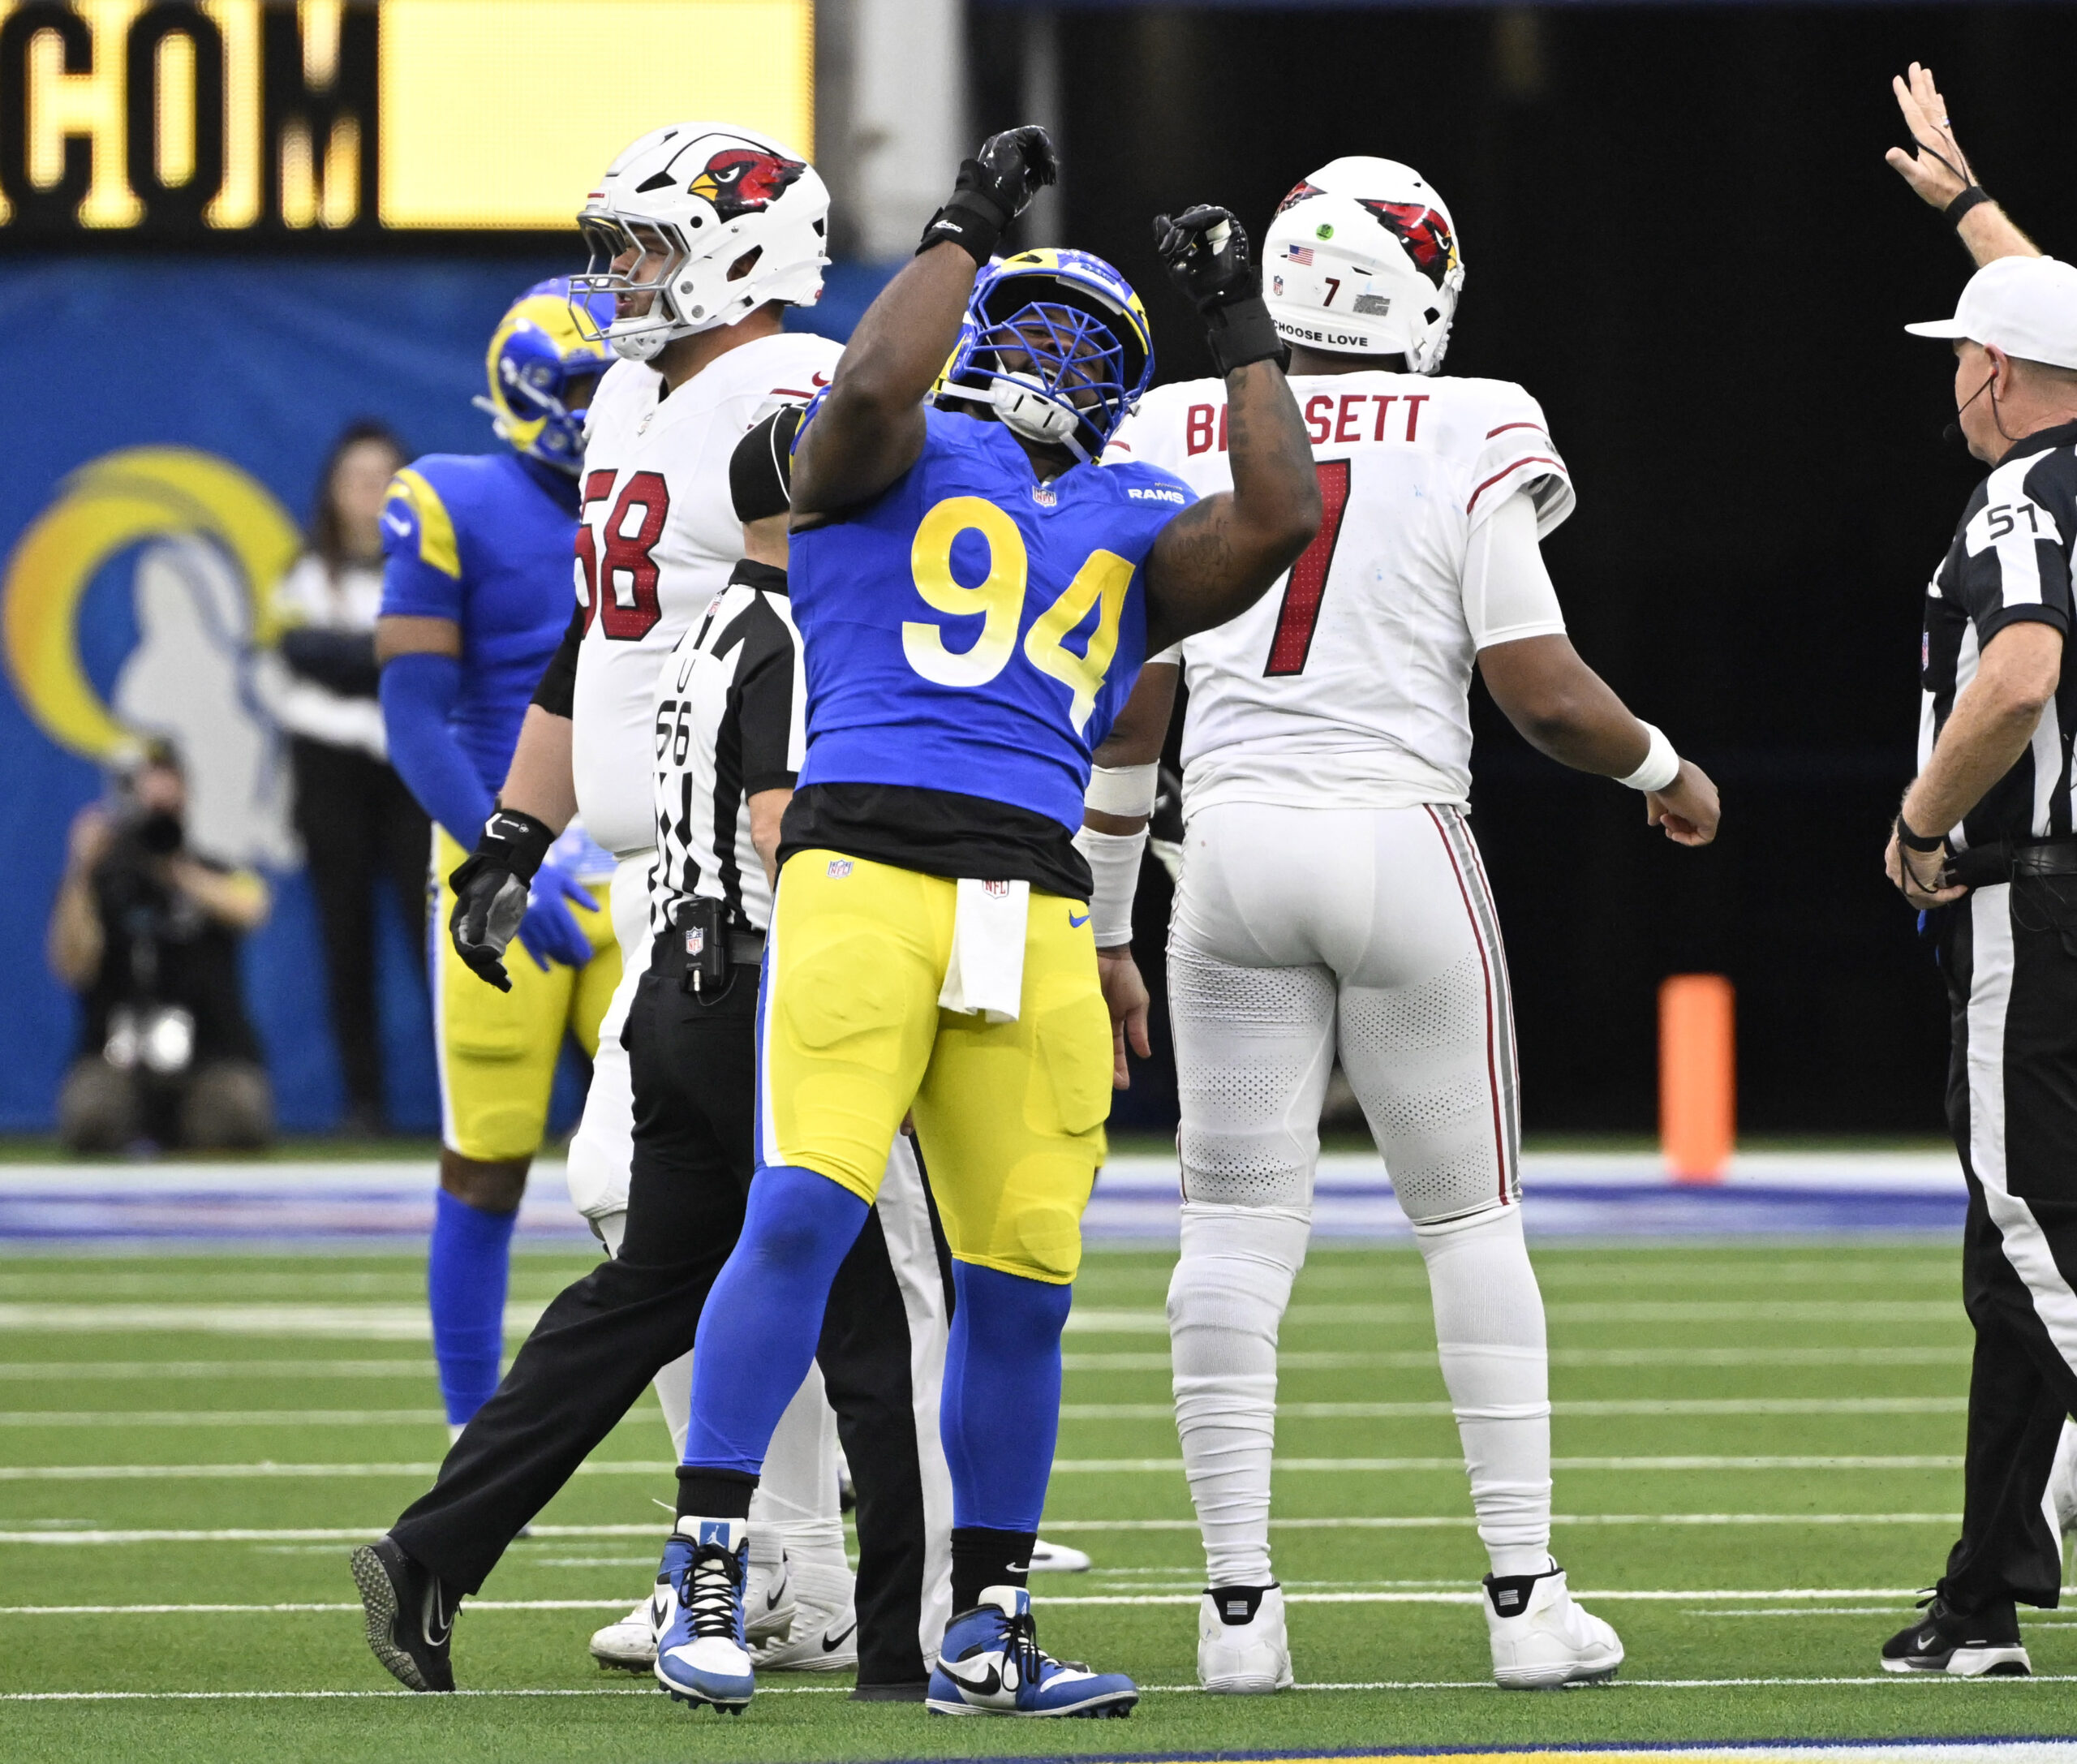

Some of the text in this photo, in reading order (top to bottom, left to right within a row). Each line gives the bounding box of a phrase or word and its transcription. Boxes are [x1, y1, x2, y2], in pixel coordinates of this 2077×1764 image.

[1322, 277, 1340, 308] 7
[1327, 333, 1369, 346] LOVE
[1128, 488, 1185, 505] RAMS
[1987, 502, 2039, 541] 51
[574, 468, 671, 642] 58
[901, 495, 1136, 739] 94
[677, 658, 696, 694] U
[985, 879, 1006, 895] NFL
